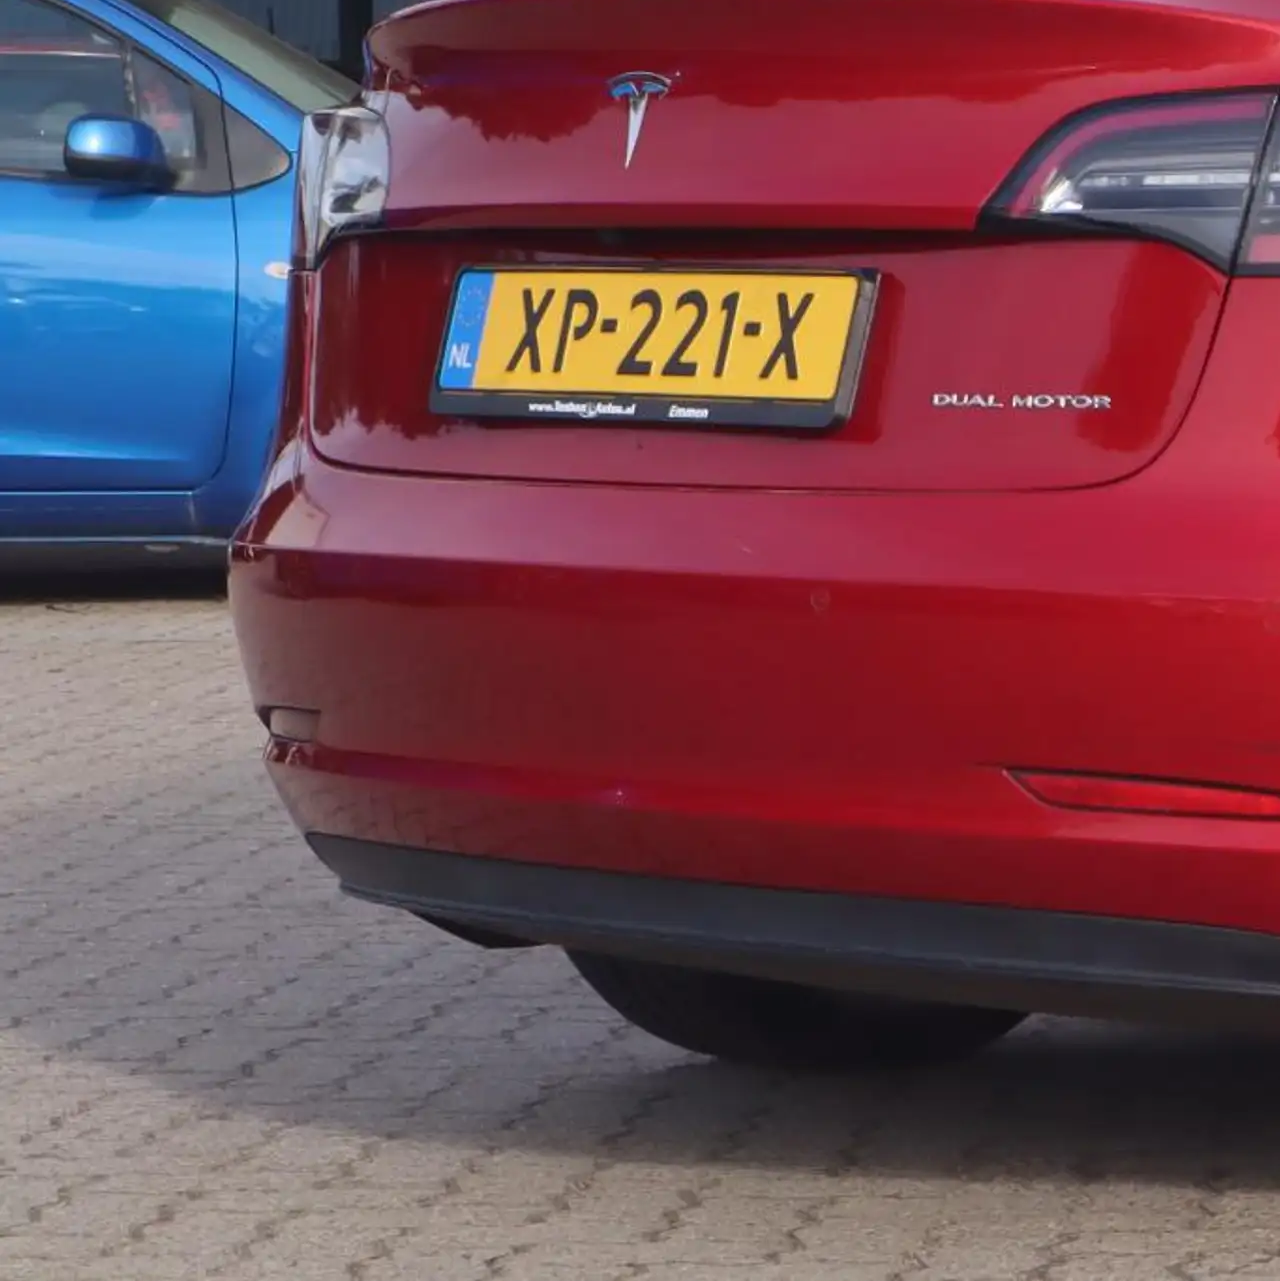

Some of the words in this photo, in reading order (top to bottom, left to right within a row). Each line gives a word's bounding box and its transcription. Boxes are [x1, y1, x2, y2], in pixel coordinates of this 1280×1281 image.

[504, 288, 815, 380] XP-221-X
[448, 343, 473, 369] NL
[668, 403, 709, 420] Emmen
[932, 393, 1004, 408] DUAL
[1012, 394, 1112, 409] MOTOR
